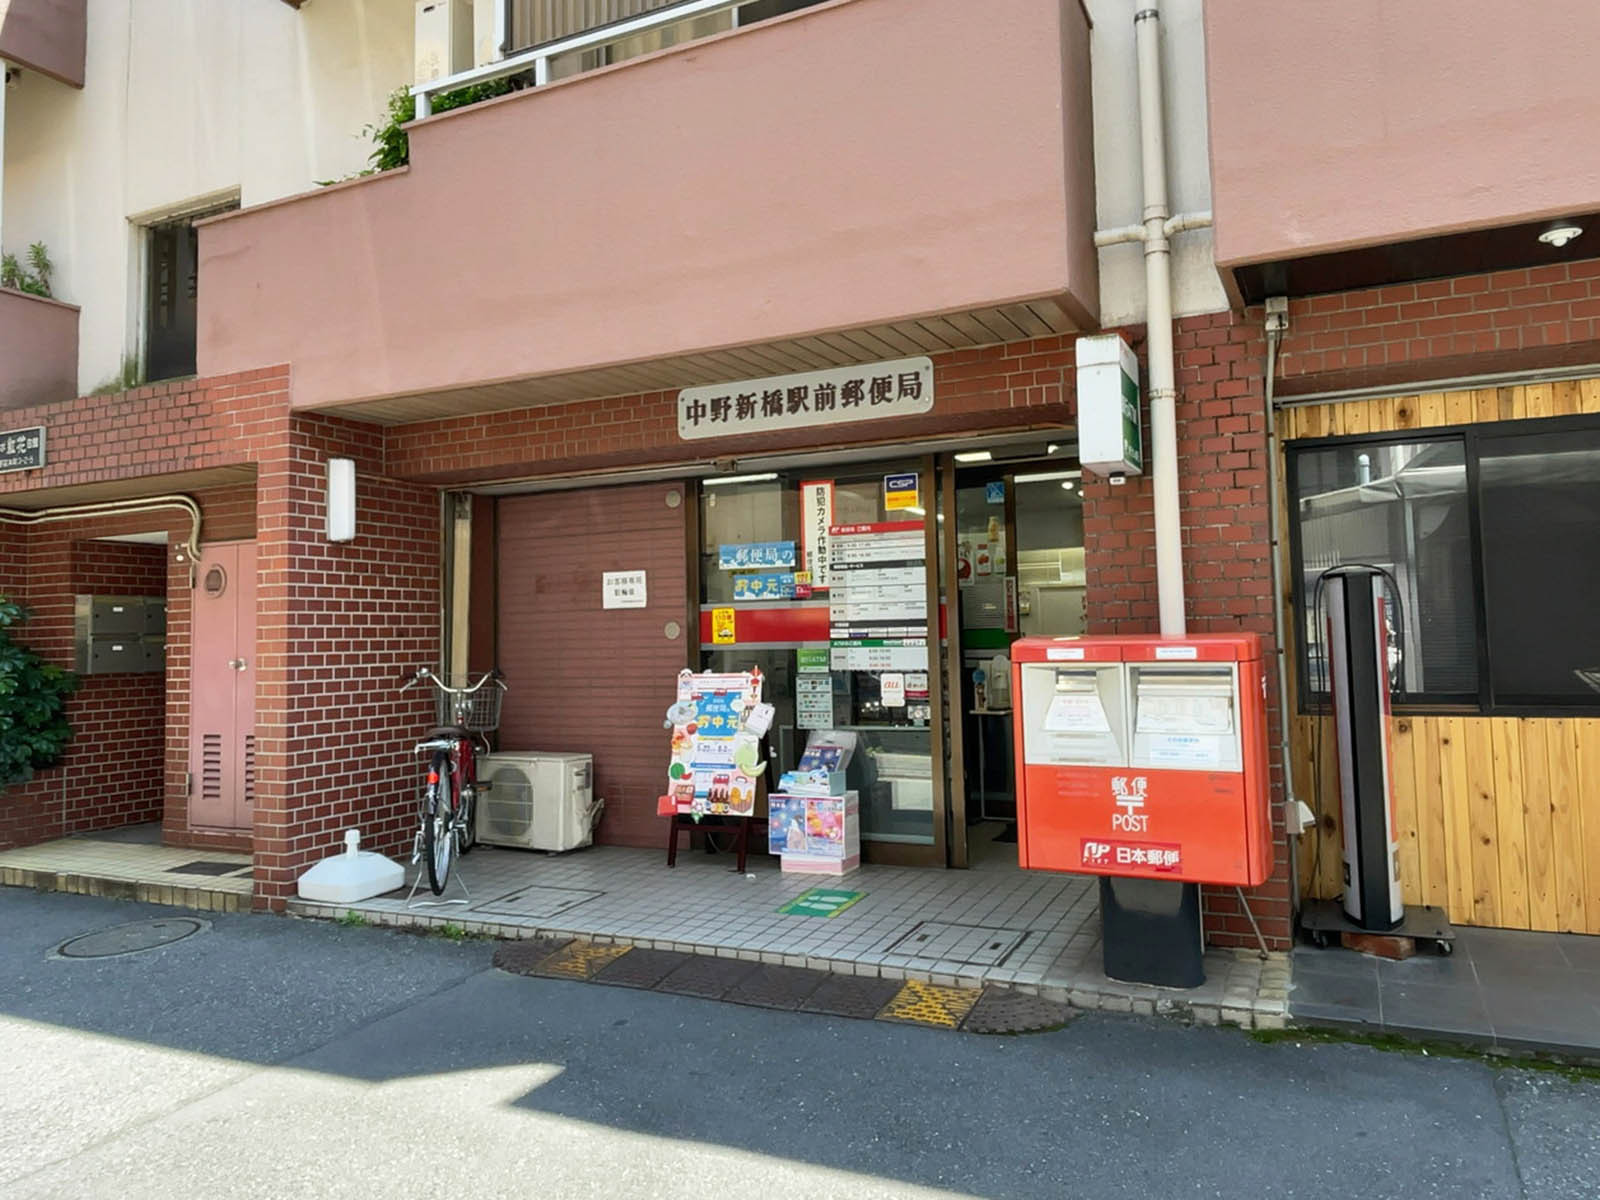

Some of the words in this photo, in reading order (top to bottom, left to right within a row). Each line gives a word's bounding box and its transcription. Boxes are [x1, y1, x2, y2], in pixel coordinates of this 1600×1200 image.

[686, 371, 922, 426] 中野新橋駅前郵便局
[889, 479, 914, 489] CSP
[815, 486, 828, 585] 防犯カメラ作動中です
[735, 548, 793, 563] 郵便局の
[735, 578, 779, 595] お中元
[697, 714, 737, 729] お中元
[1111, 776, 1148, 798] 郵便
[1112, 813, 1149, 832] POST
[1116, 847, 1180, 866] 日本郵便
